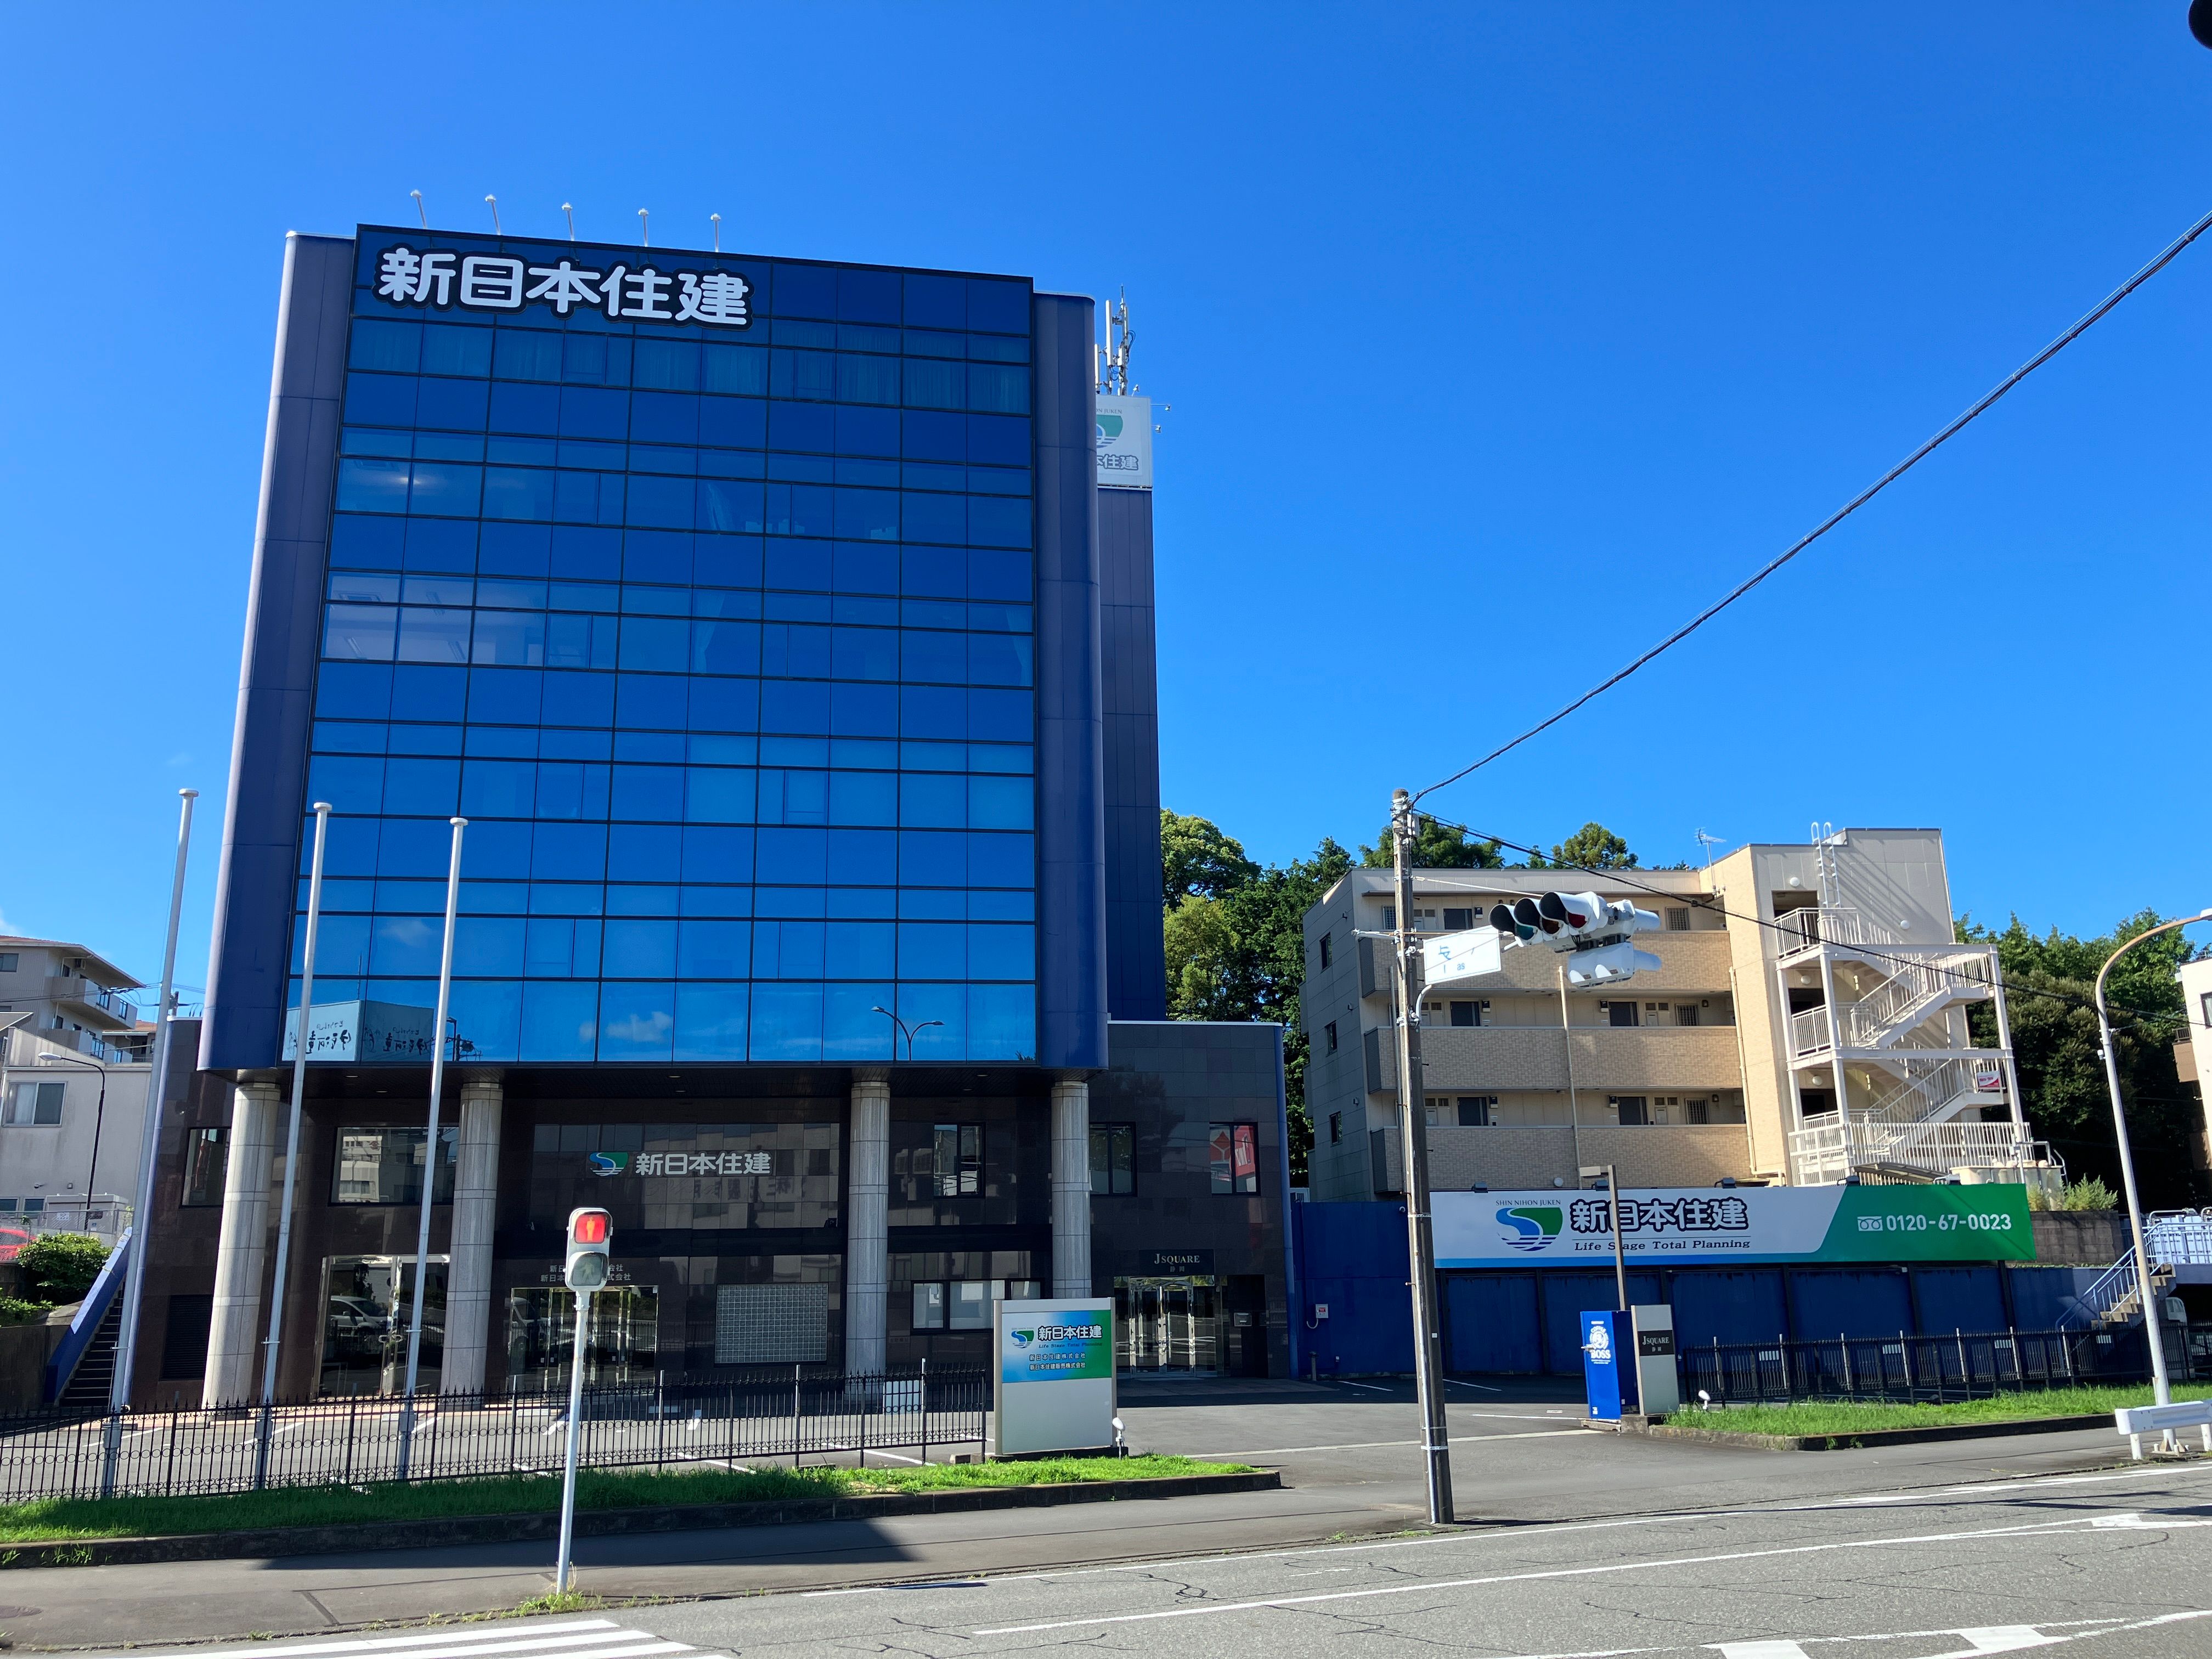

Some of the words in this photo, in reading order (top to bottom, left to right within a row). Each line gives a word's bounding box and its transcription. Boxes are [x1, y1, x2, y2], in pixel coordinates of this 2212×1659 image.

[377, 245, 750, 328] 新日本住建
[636, 1152, 771, 1176] 新日本住建
[1570, 1197, 1748, 1233] 新日本住建
[1886, 1214, 2012, 1232] 0120-67-0023
[1575, 1242, 1601, 1250] Life
[1608, 1242, 1645, 1251] Sage
[1652, 1240, 1686, 1249] Total
[1692, 1239, 1751, 1250] Planning
[1037, 1324, 1102, 1341] 新日本住建
[1591, 1349, 1611, 1359] BOSS
